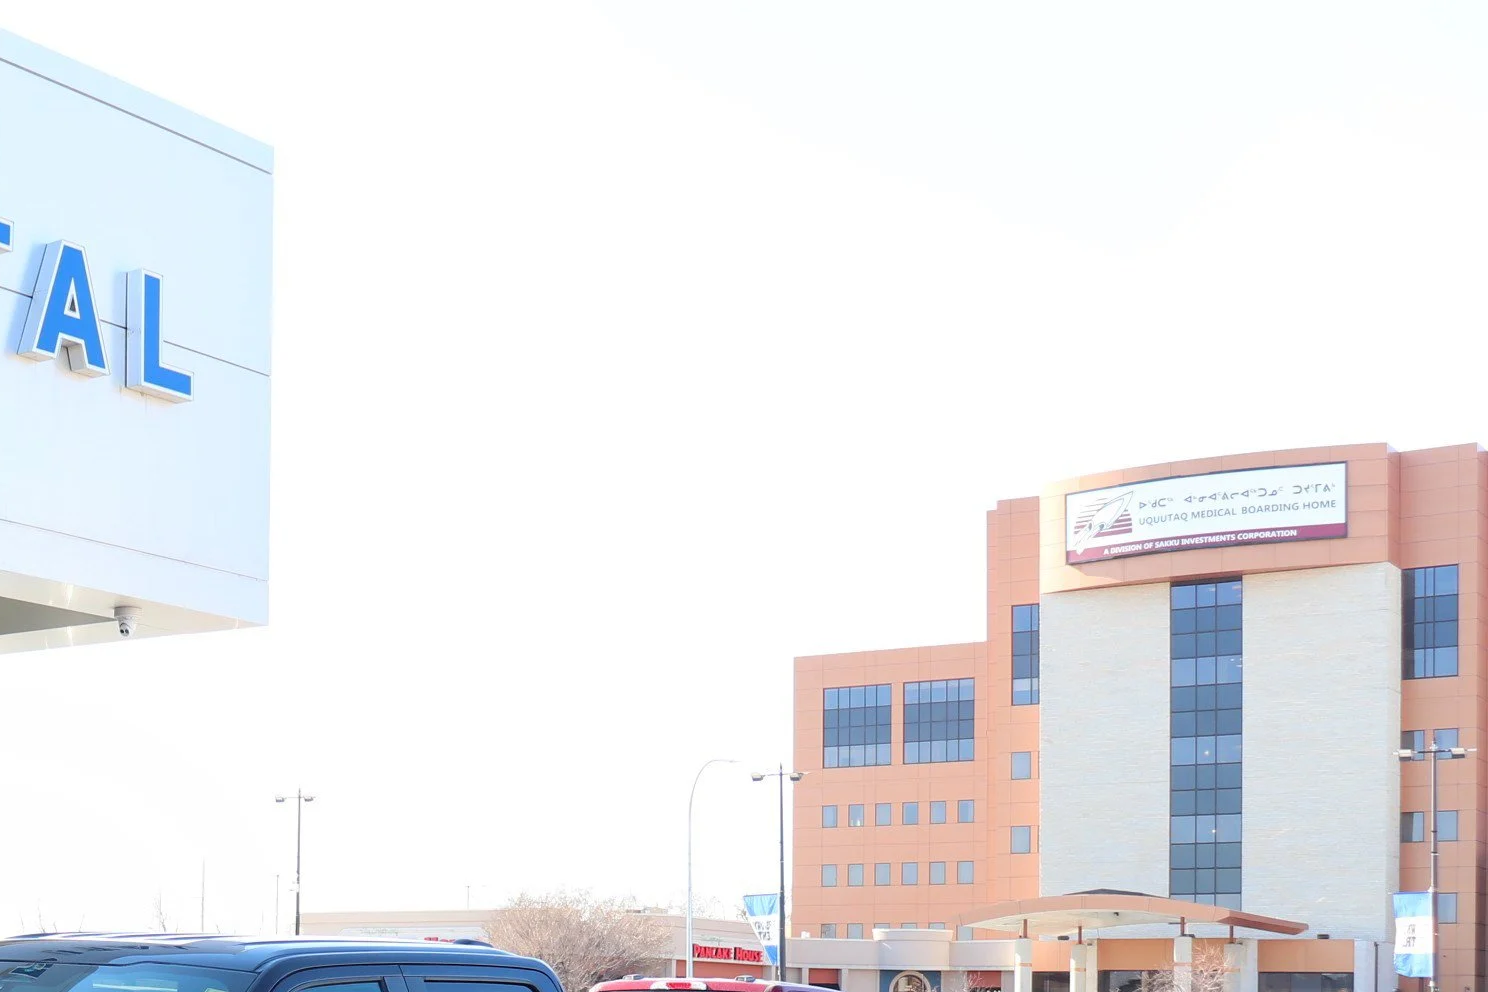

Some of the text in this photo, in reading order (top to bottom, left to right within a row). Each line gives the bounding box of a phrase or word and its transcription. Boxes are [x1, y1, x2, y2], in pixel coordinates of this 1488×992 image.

[1138, 499, 1337, 526] UQUUTAQ MEDICAL BOARDING HOME
[1110, 544, 1143, 554] DIVISION
[1155, 539, 1180, 549] SAKKU
[1181, 533, 1236, 546] INVESTMENTS
[1237, 529, 1297, 541] CORPORATION
[692, 943, 764, 962] PANCAKE HOUSE
